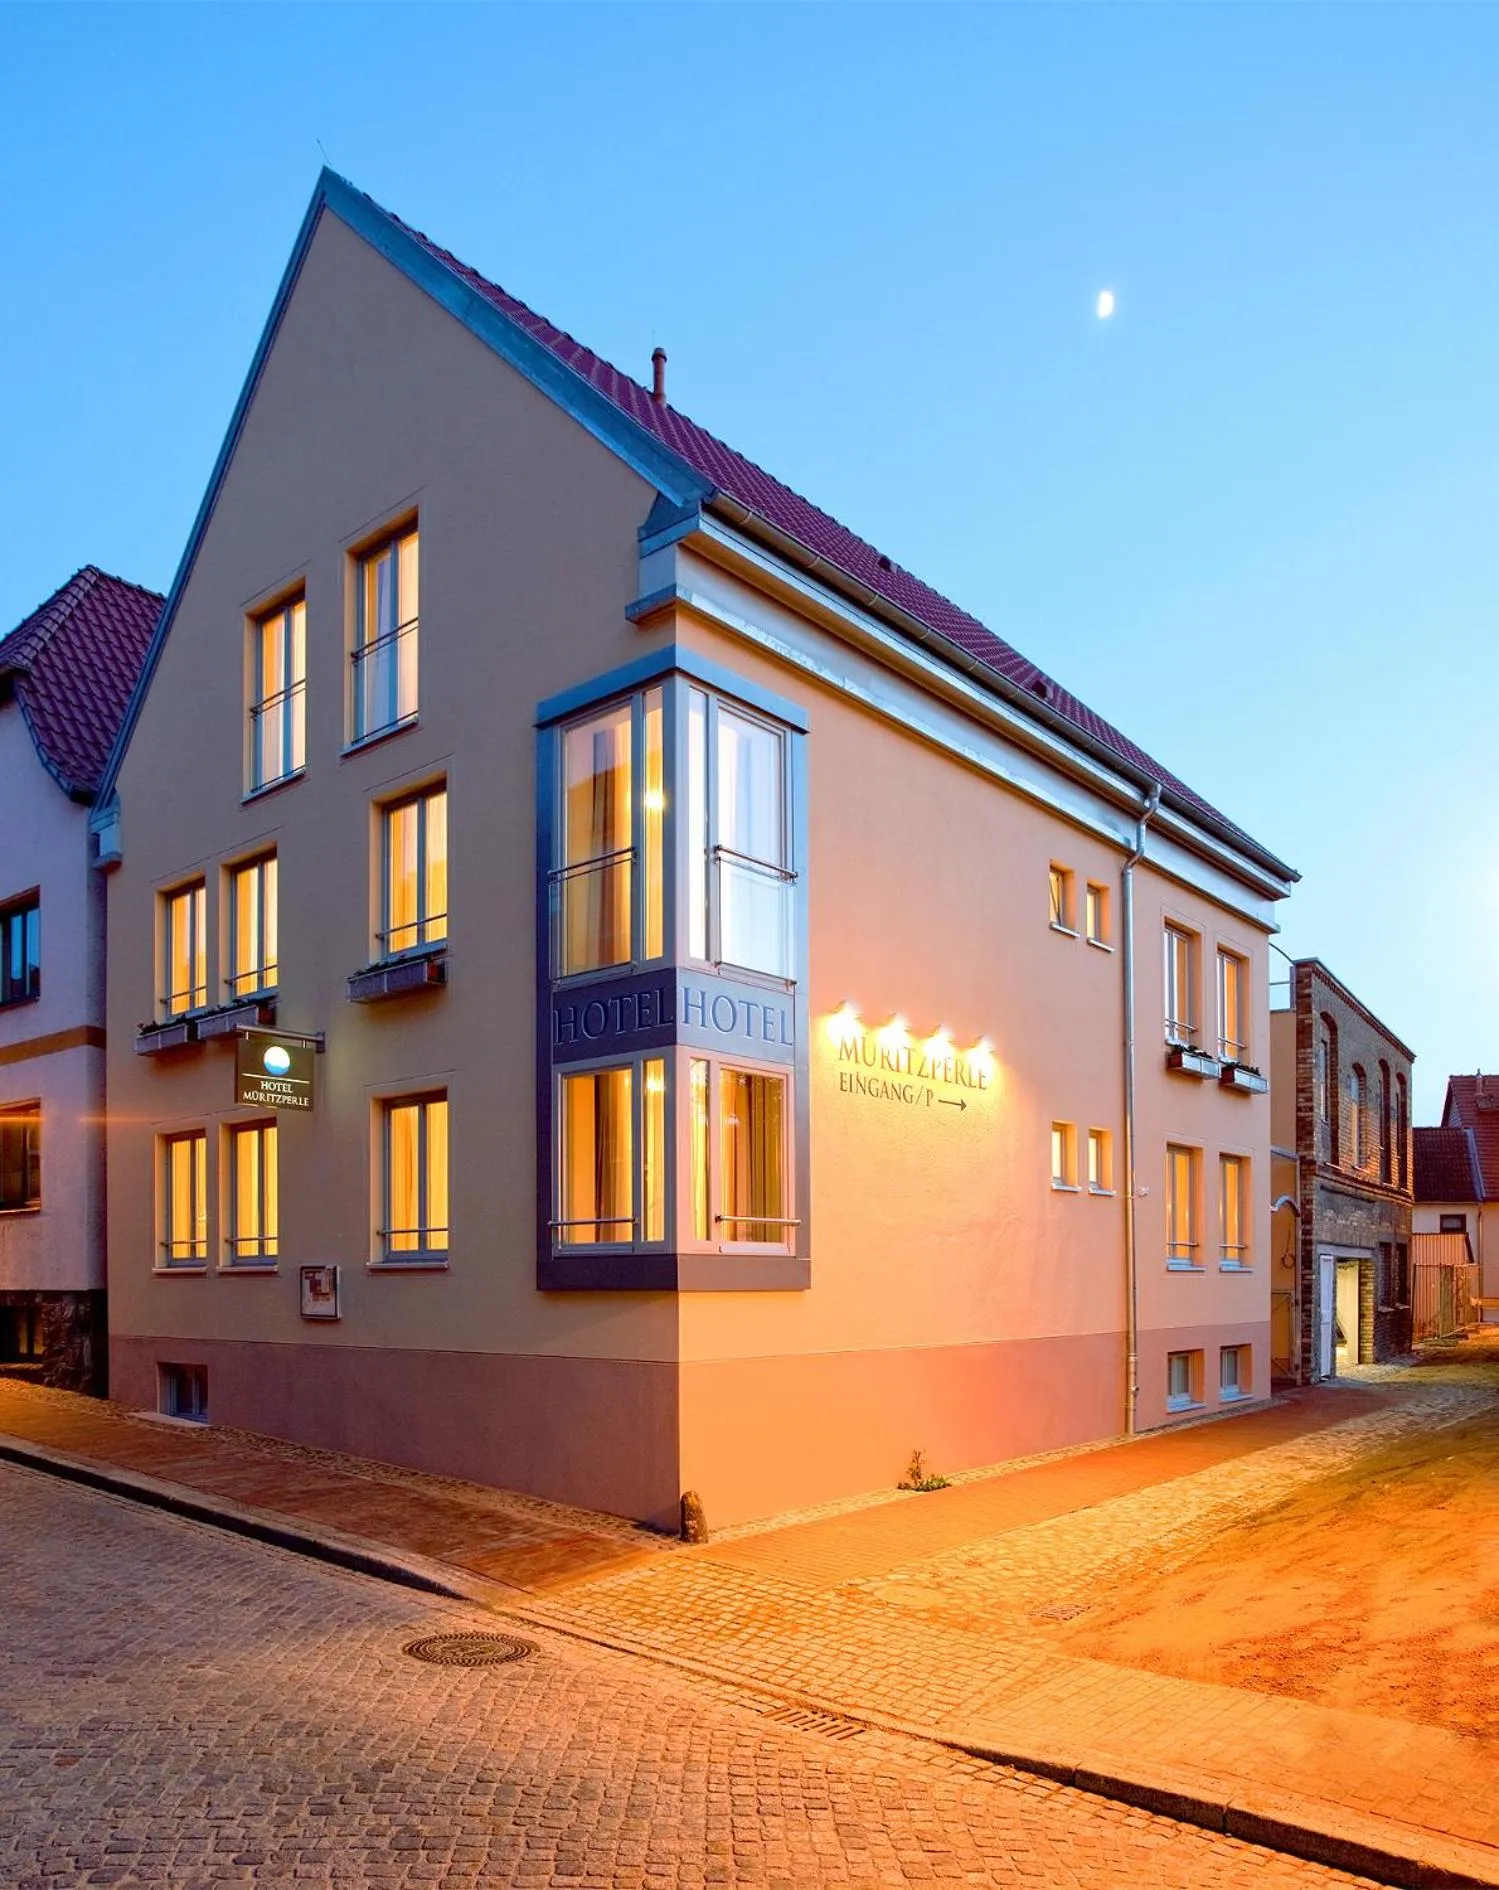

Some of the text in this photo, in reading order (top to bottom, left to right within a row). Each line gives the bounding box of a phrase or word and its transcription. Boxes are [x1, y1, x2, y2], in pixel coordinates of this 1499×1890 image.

[554, 987, 674, 1046] HOTEL
[680, 987, 793, 1046] HOTEL
[260, 1080, 293, 1093] HOTEL
[839, 1030, 988, 1090] MÜRITZPERLE
[243, 1090, 309, 1107] MÜRITZPERLE
